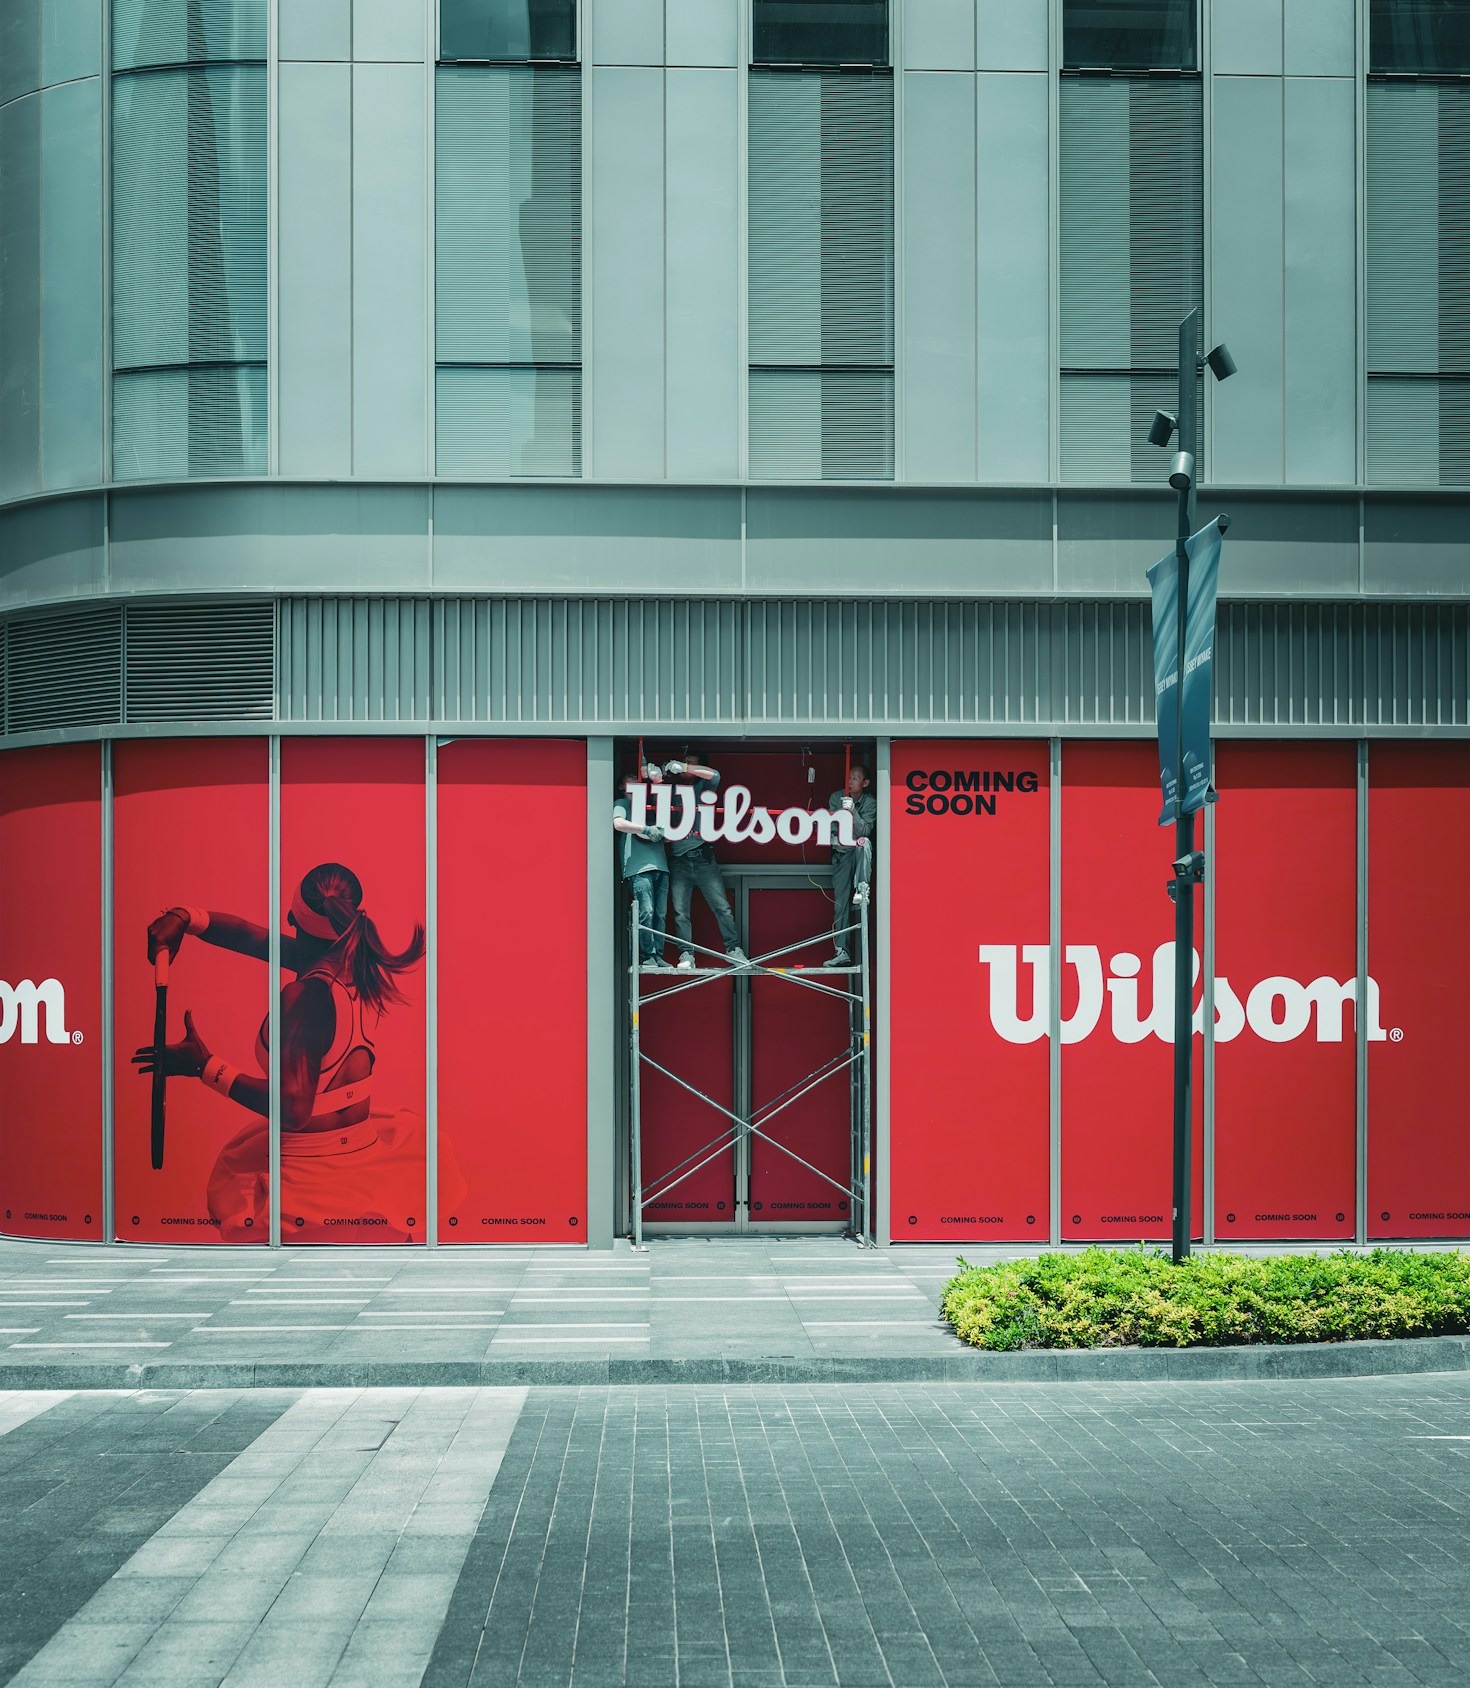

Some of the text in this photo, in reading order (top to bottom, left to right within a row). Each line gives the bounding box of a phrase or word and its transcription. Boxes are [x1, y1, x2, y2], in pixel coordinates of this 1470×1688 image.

[905, 770, 1039, 792] COMING
[905, 793, 997, 816] SOON
[626, 783, 858, 847] Wilson
[979, 941, 1387, 1044] Wilson
[24, 1212, 67, 1222] COMING SOON
[940, 1216, 1004, 1224] COMING SOON
[1100, 1215, 1164, 1223] COMING SOON
[1254, 1213, 1317, 1221] COMING SOON
[1409, 1212, 1470, 1220] COMING SOON
[323, 1218, 388, 1226] COMING SOON
